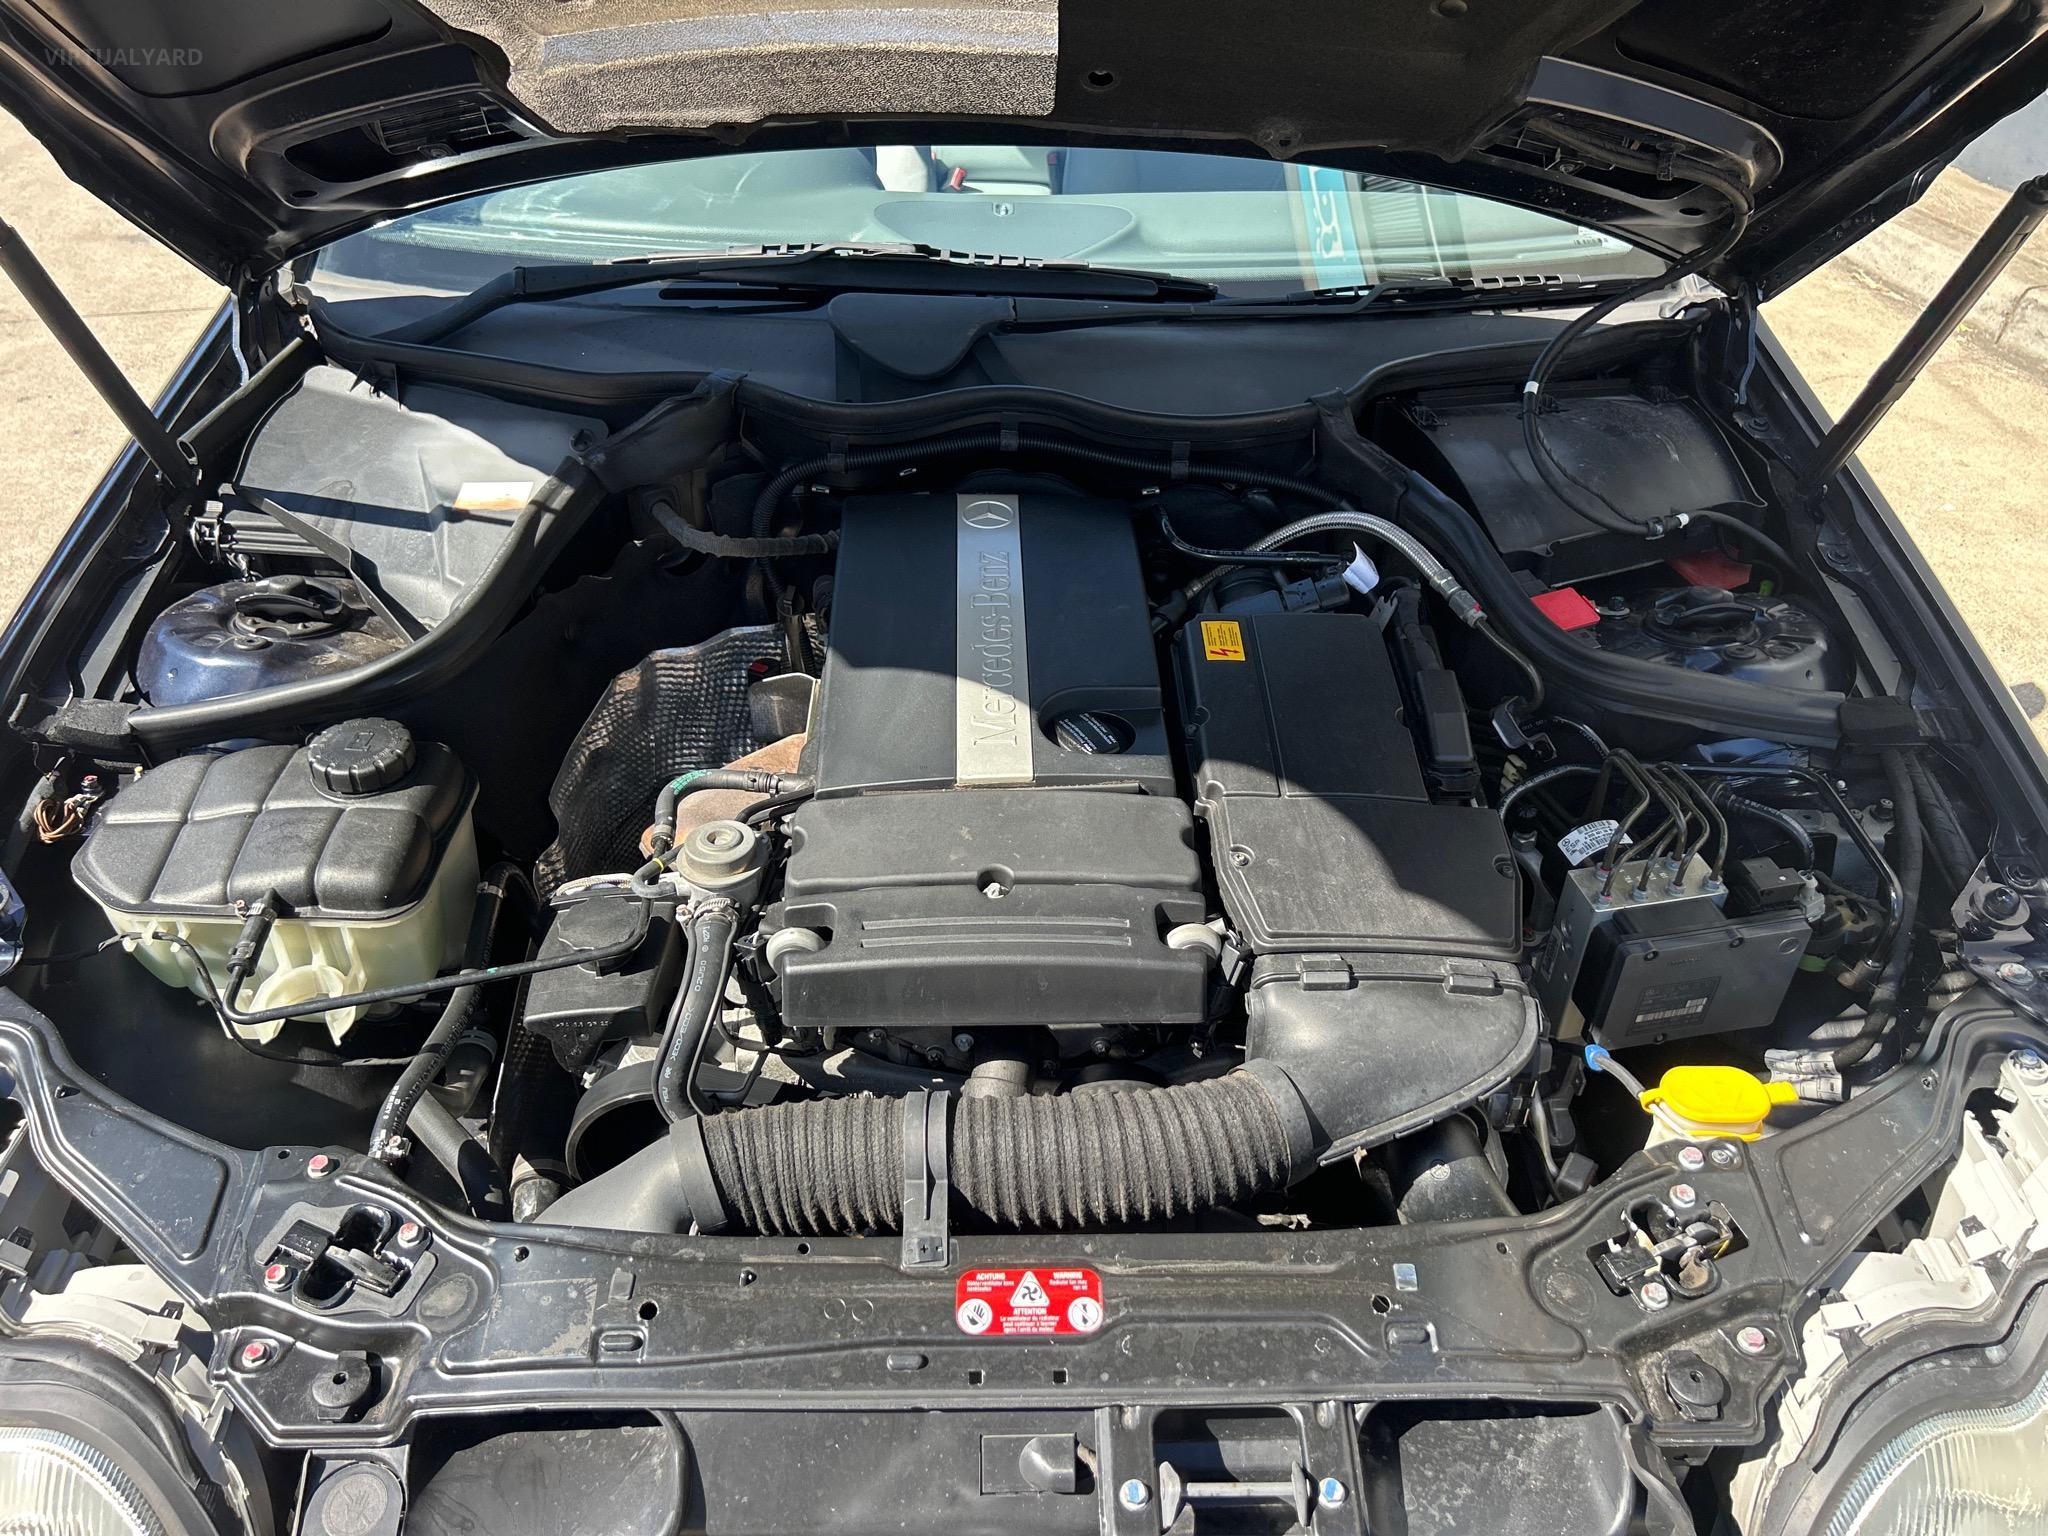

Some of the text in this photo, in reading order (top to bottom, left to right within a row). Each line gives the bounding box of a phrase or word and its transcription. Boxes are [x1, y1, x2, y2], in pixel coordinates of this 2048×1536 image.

[970, 551, 1017, 746] Mercedes-Benz
[976, 1272, 1006, 1281] ACHTUNG
[1053, 1271, 1083, 1280] WARNING
[1013, 1307, 1048, 1316] ATTENTION
